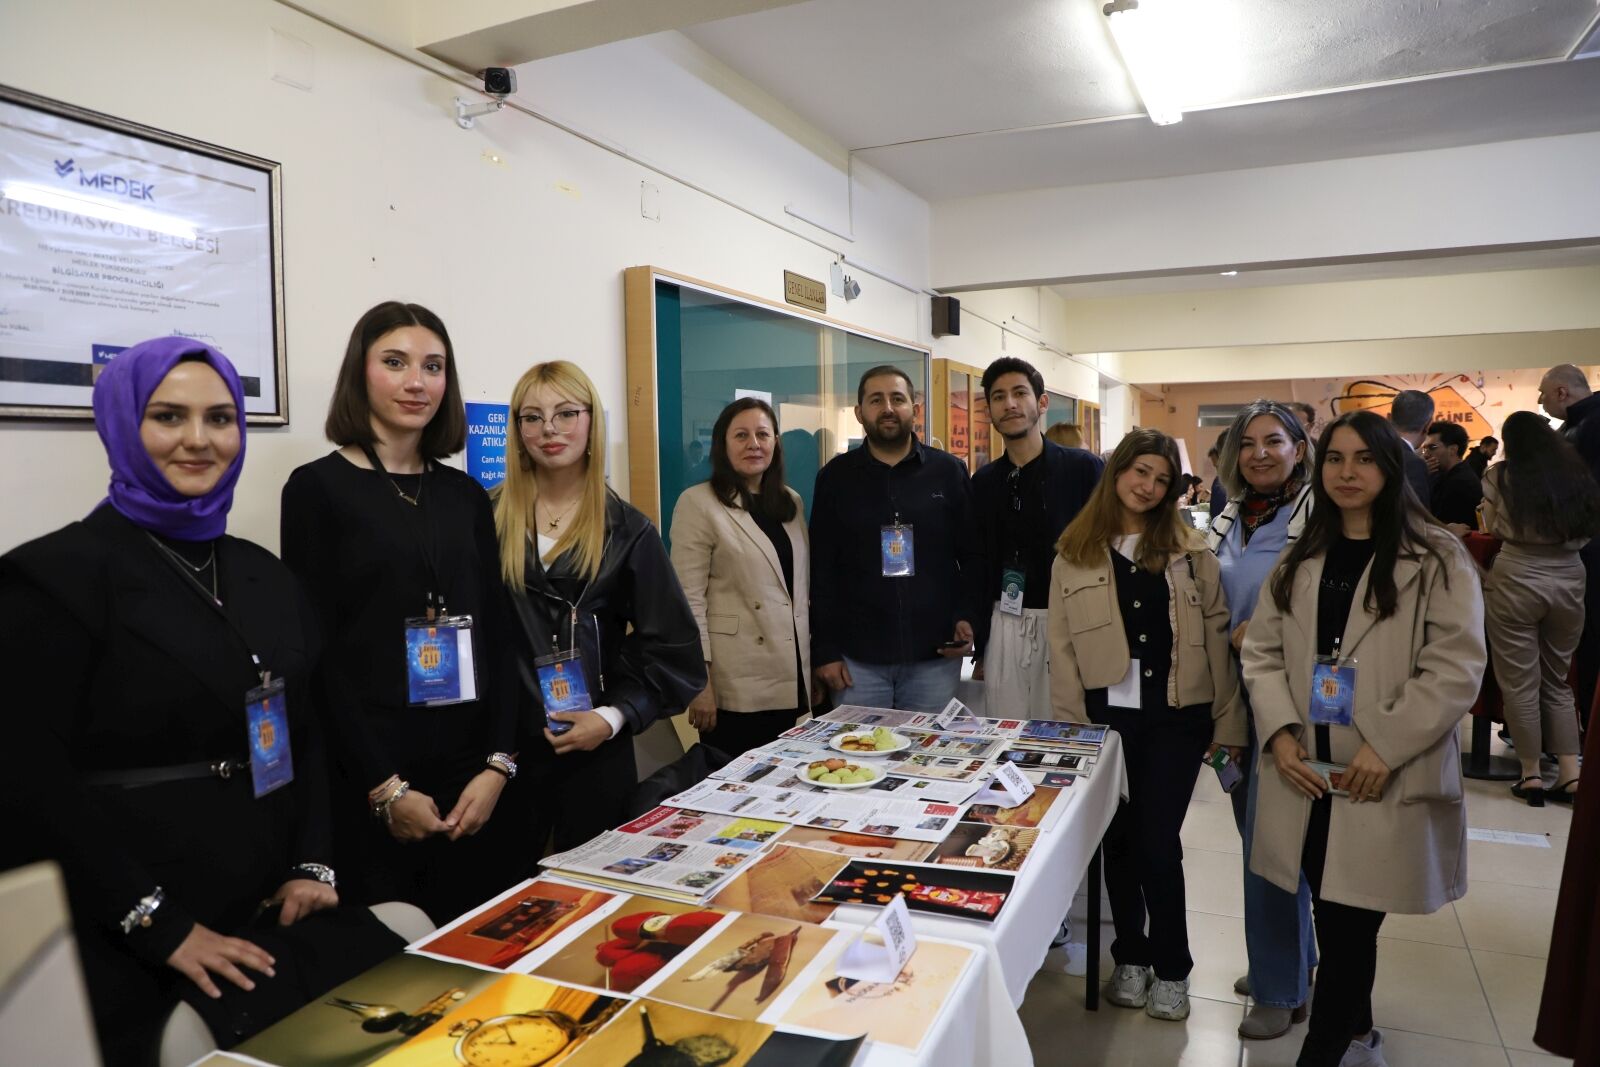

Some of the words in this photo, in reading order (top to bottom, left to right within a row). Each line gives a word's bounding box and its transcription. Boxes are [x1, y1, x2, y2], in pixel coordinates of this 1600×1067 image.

[79, 168, 155, 202] MEDEK
[469, 424, 507, 435] KAZANILA
[482, 437, 507, 447] ATIKLA
[481, 455, 495, 464] Cam
